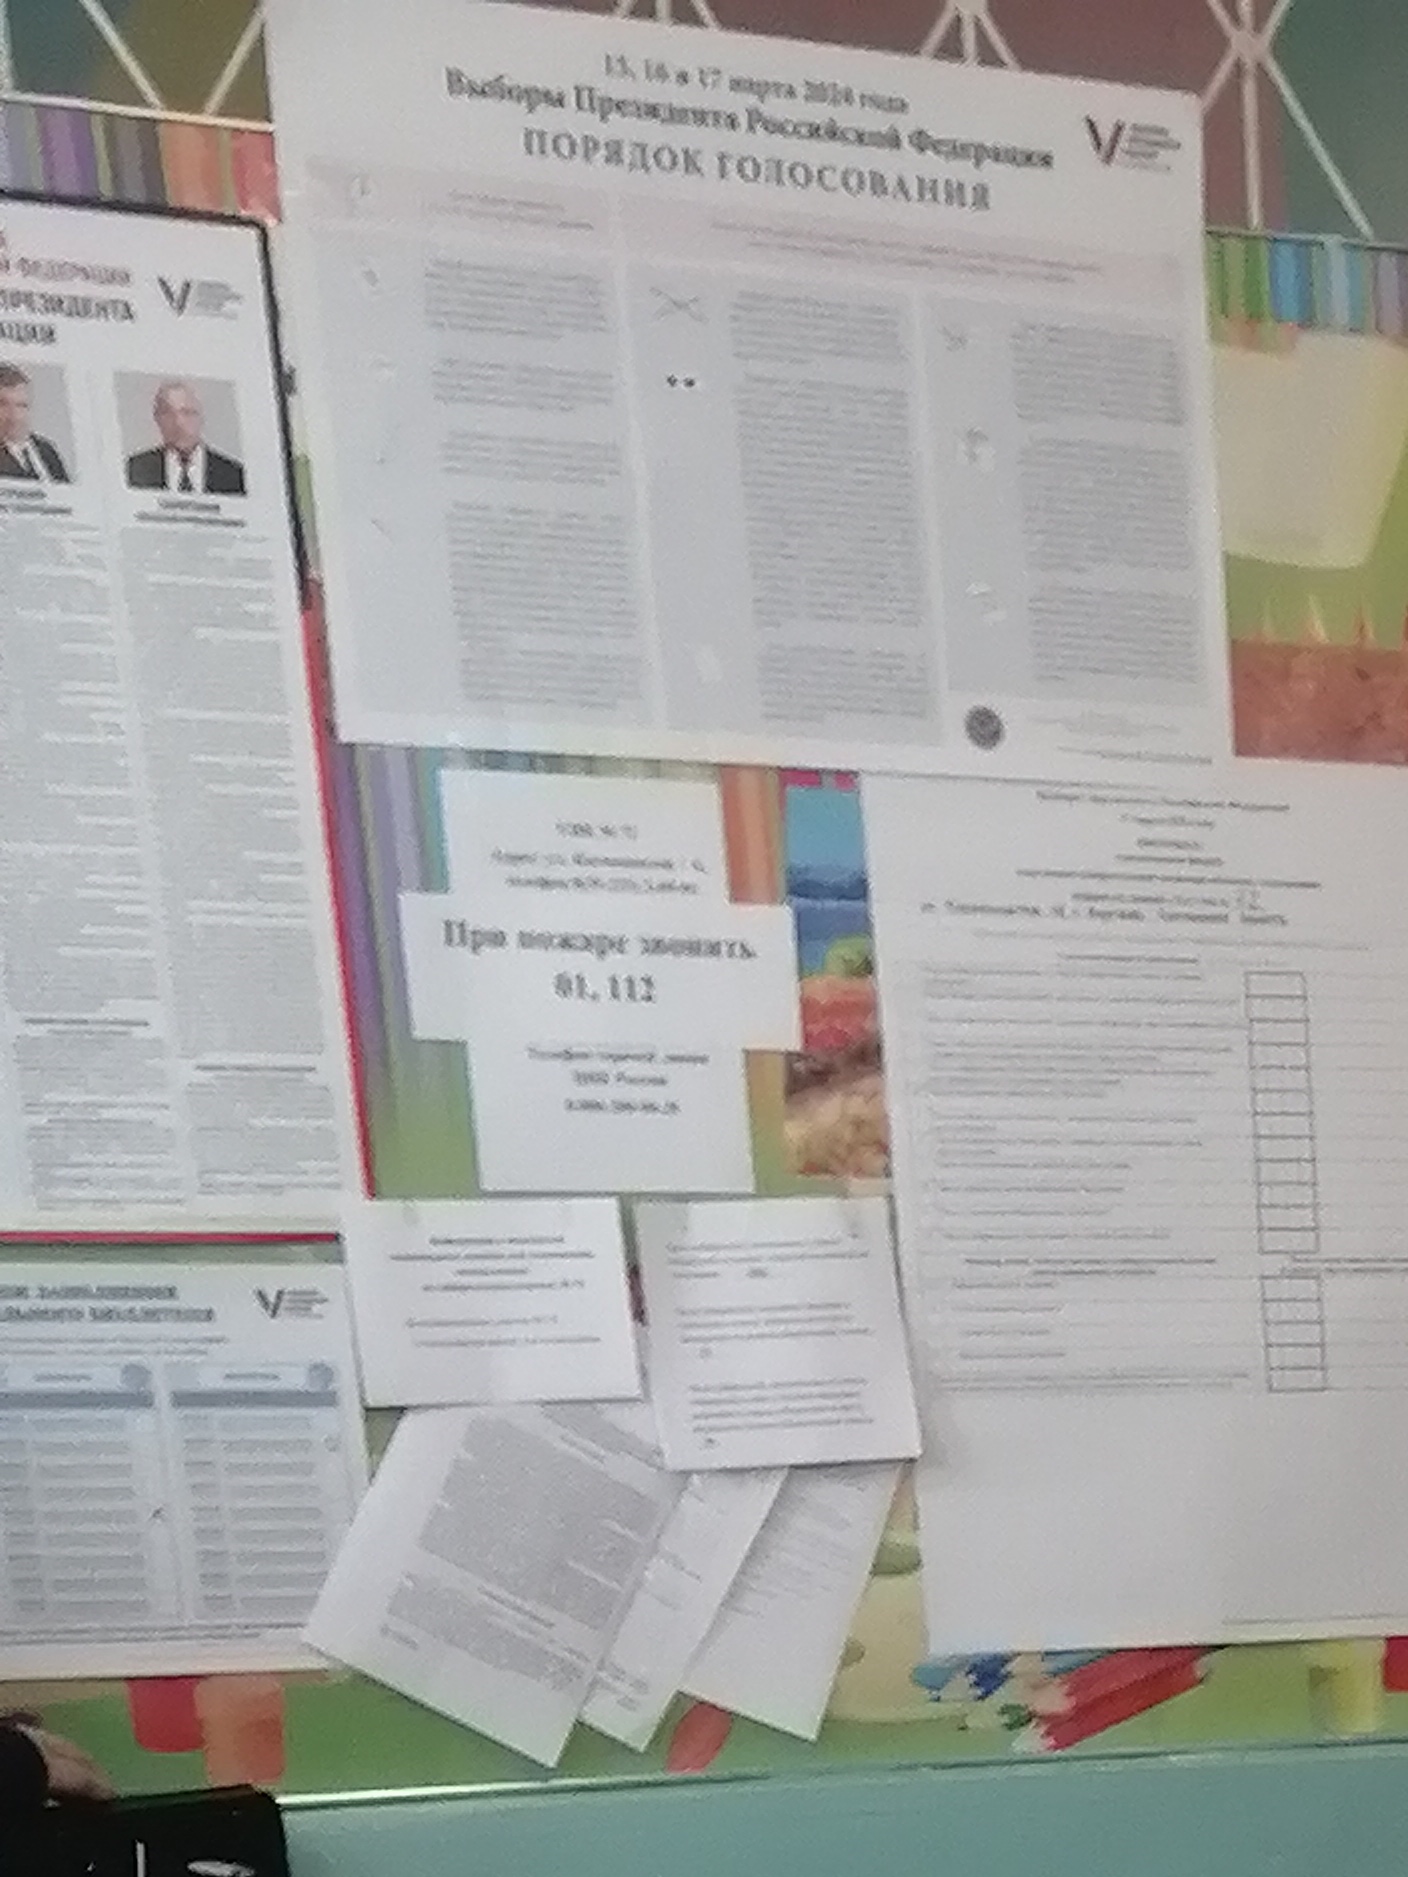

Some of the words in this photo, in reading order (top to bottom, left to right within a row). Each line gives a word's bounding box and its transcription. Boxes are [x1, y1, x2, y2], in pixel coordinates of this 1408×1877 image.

[445, 66, 565, 114] Выборы
[573, 84, 742, 124] Президента
[745, 106, 902, 151] Российской
[907, 127, 1055, 171] Федерации
[523, 126, 705, 178] ПОРЯДОК
[715, 150, 991, 211] ГОЛОСОВАНИЯ
[443, 918, 507, 957] При
[517, 928, 629, 962] пожаре
[638, 934, 759, 961] звонить
[608, 973, 658, 1004] 112
